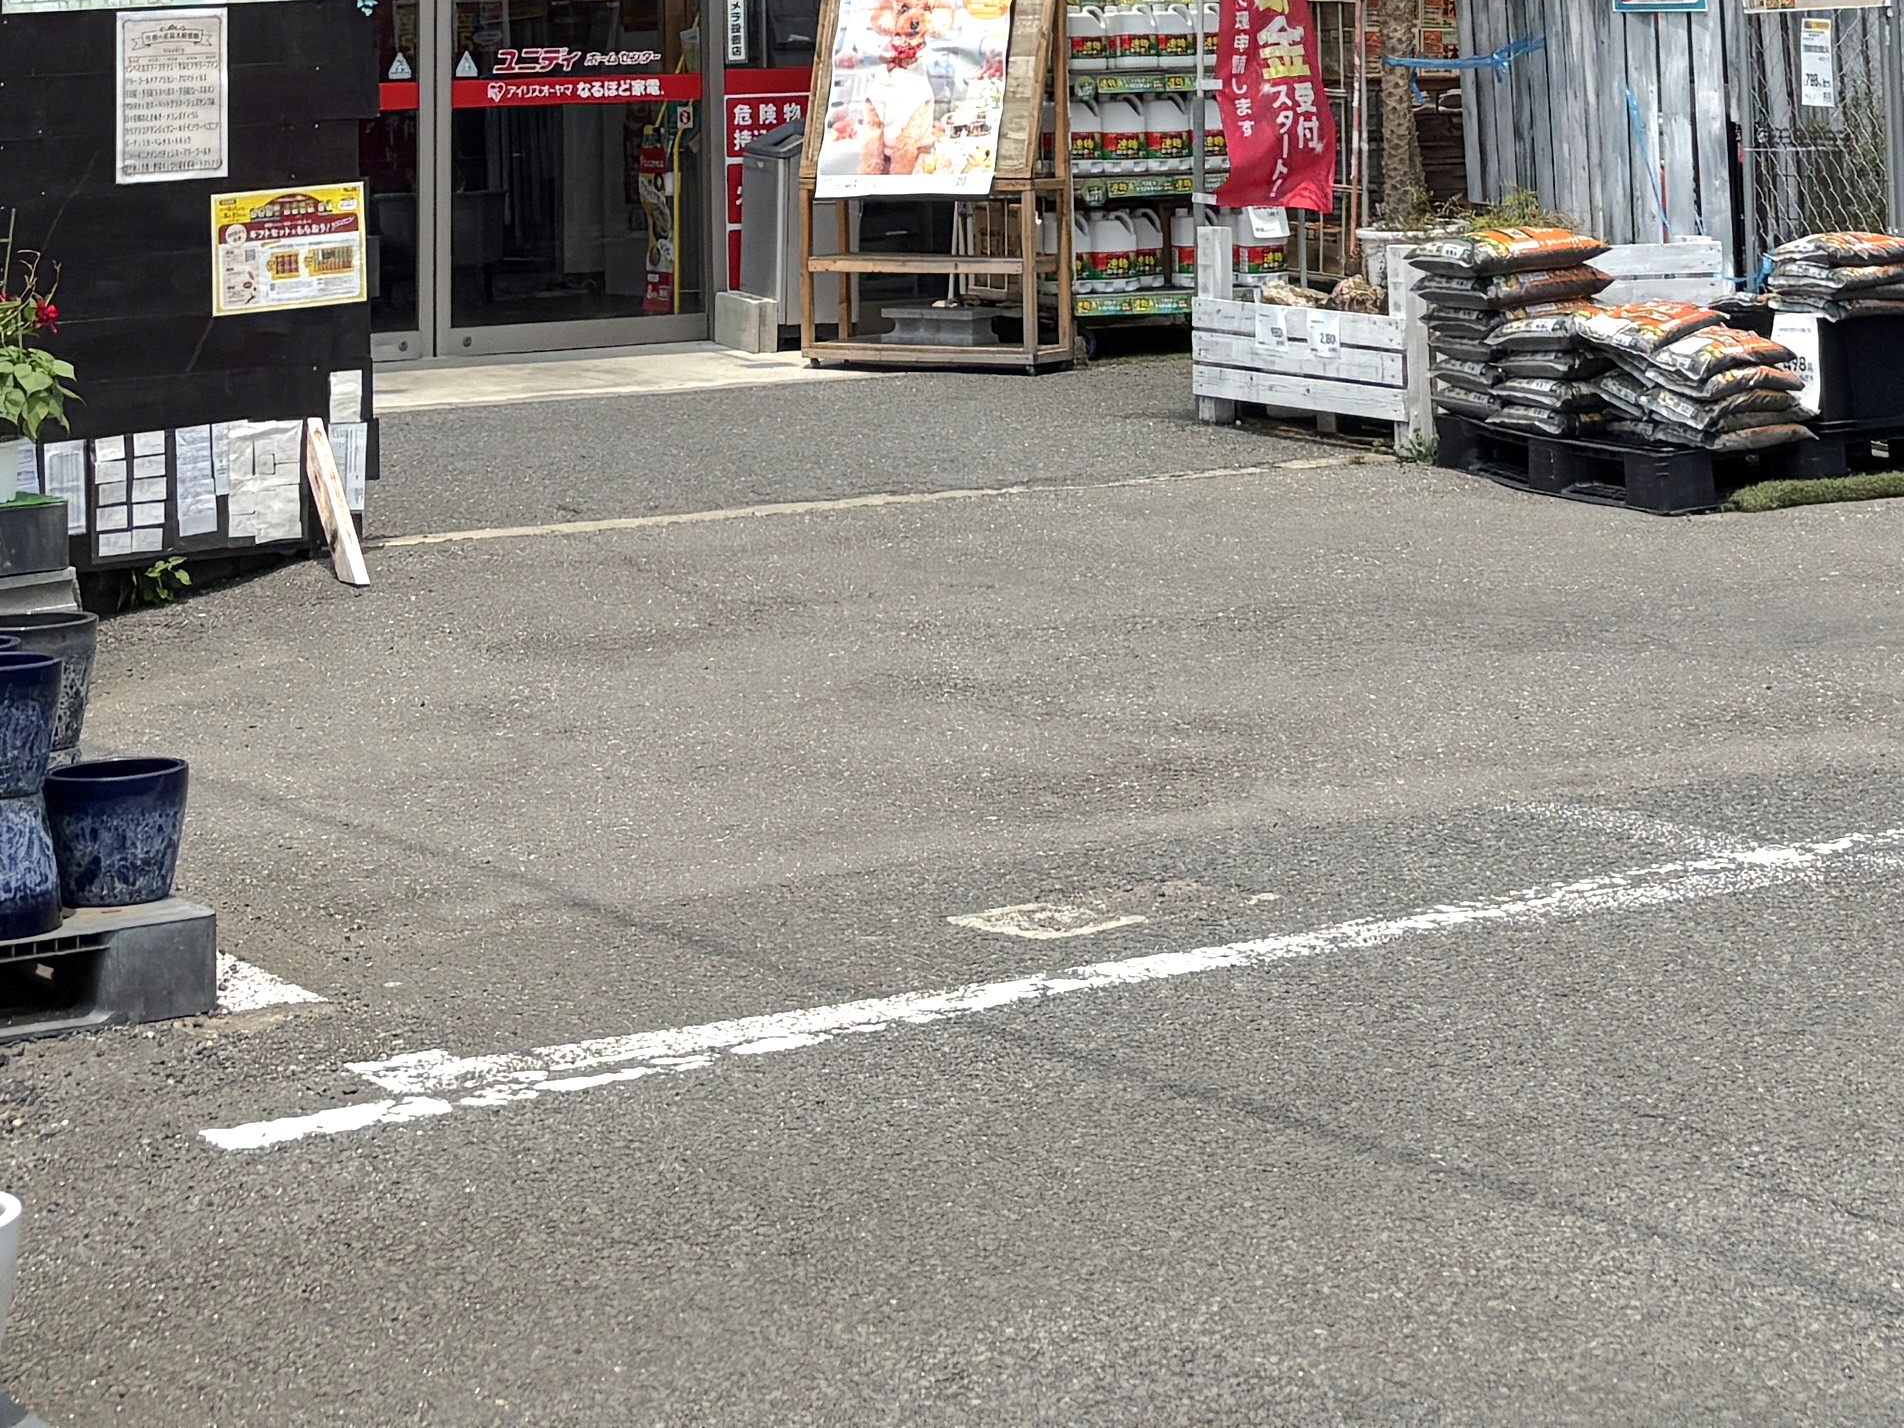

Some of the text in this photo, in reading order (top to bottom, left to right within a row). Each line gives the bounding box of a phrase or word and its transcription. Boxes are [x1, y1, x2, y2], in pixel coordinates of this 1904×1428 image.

[492, 46, 663, 74] ユニディ ホームセンター
[506, 78, 662, 99] アイリスオーヤマ なるほど家電
[732, 101, 803, 126] 危険物
[1292, 81, 1323, 152] 受付
